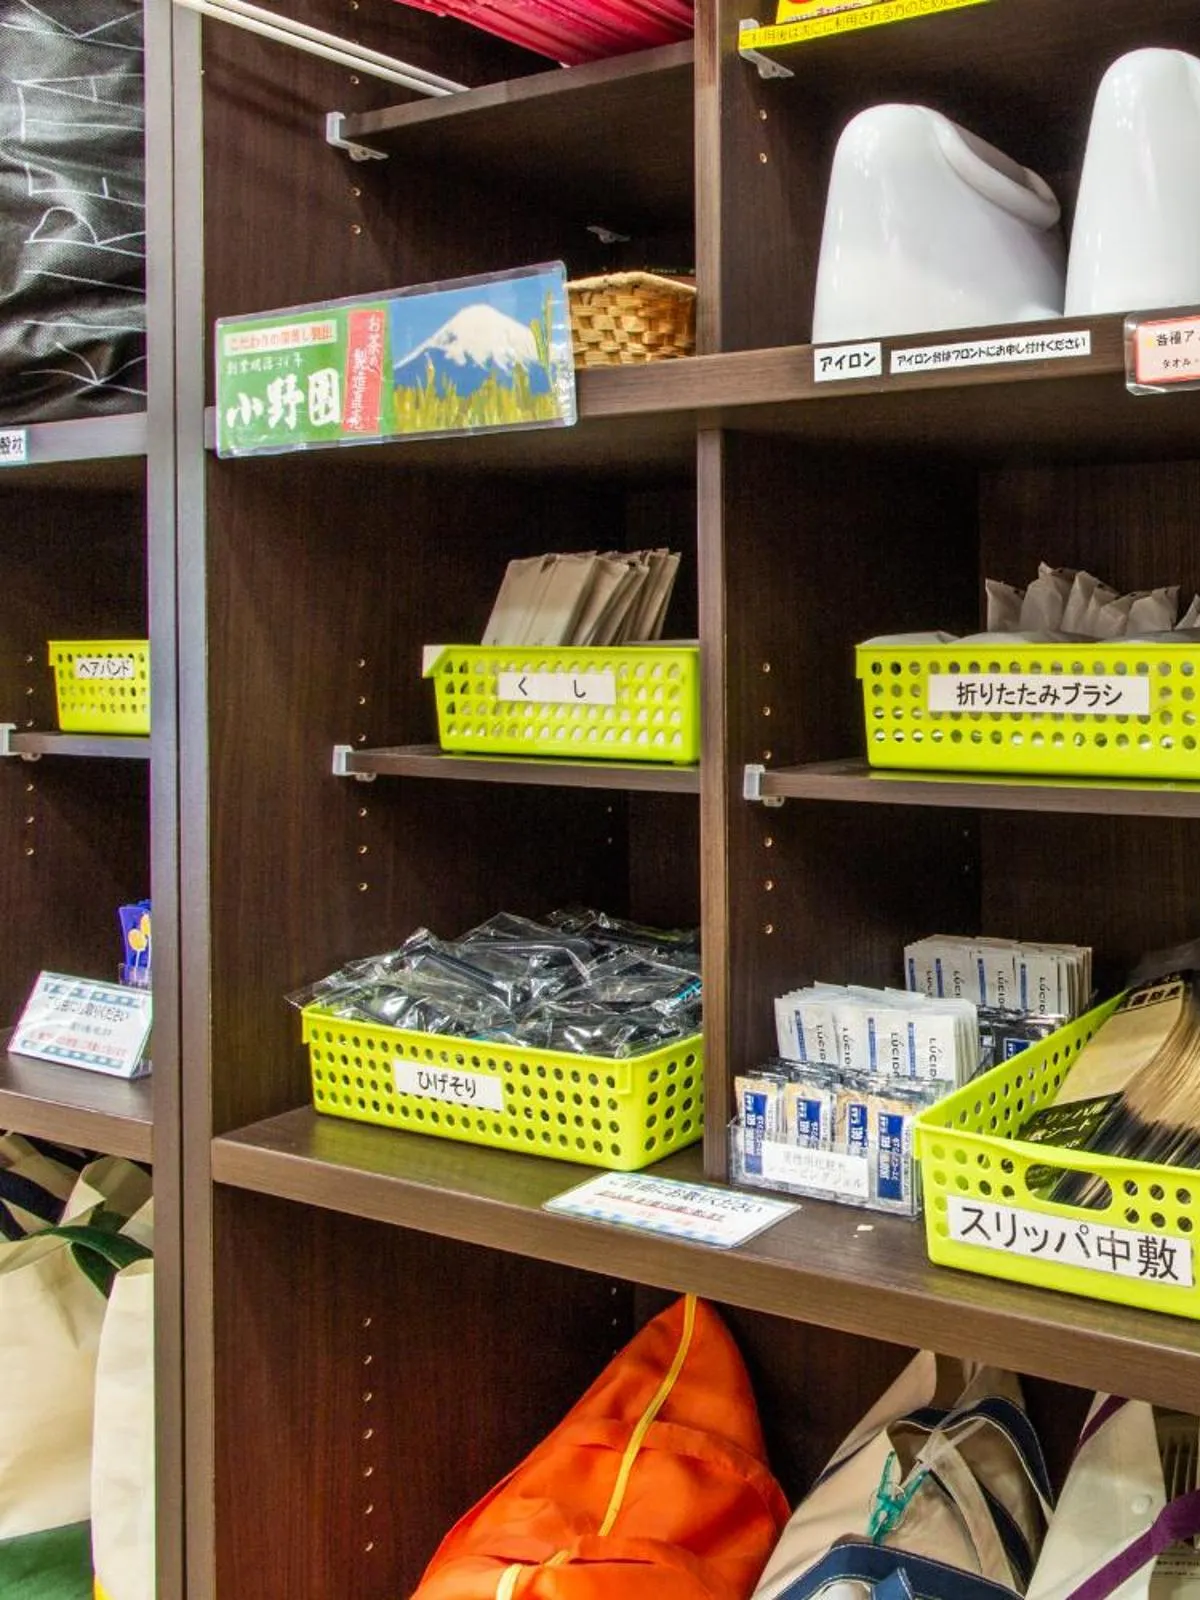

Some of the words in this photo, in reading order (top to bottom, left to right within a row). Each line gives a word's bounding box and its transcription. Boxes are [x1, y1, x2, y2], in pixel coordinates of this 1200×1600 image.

[820, 352, 877, 373] アイロン
[896, 337, 1086, 367] アイロン台はフロントにお申し付けください
[79, 659, 131, 676] ヘアバンド
[956, 680, 1124, 707] 折りたたみブラシ
[416, 1071, 477, 1100] ひげそり
[960, 1205, 1179, 1282] スリッパ中敷
